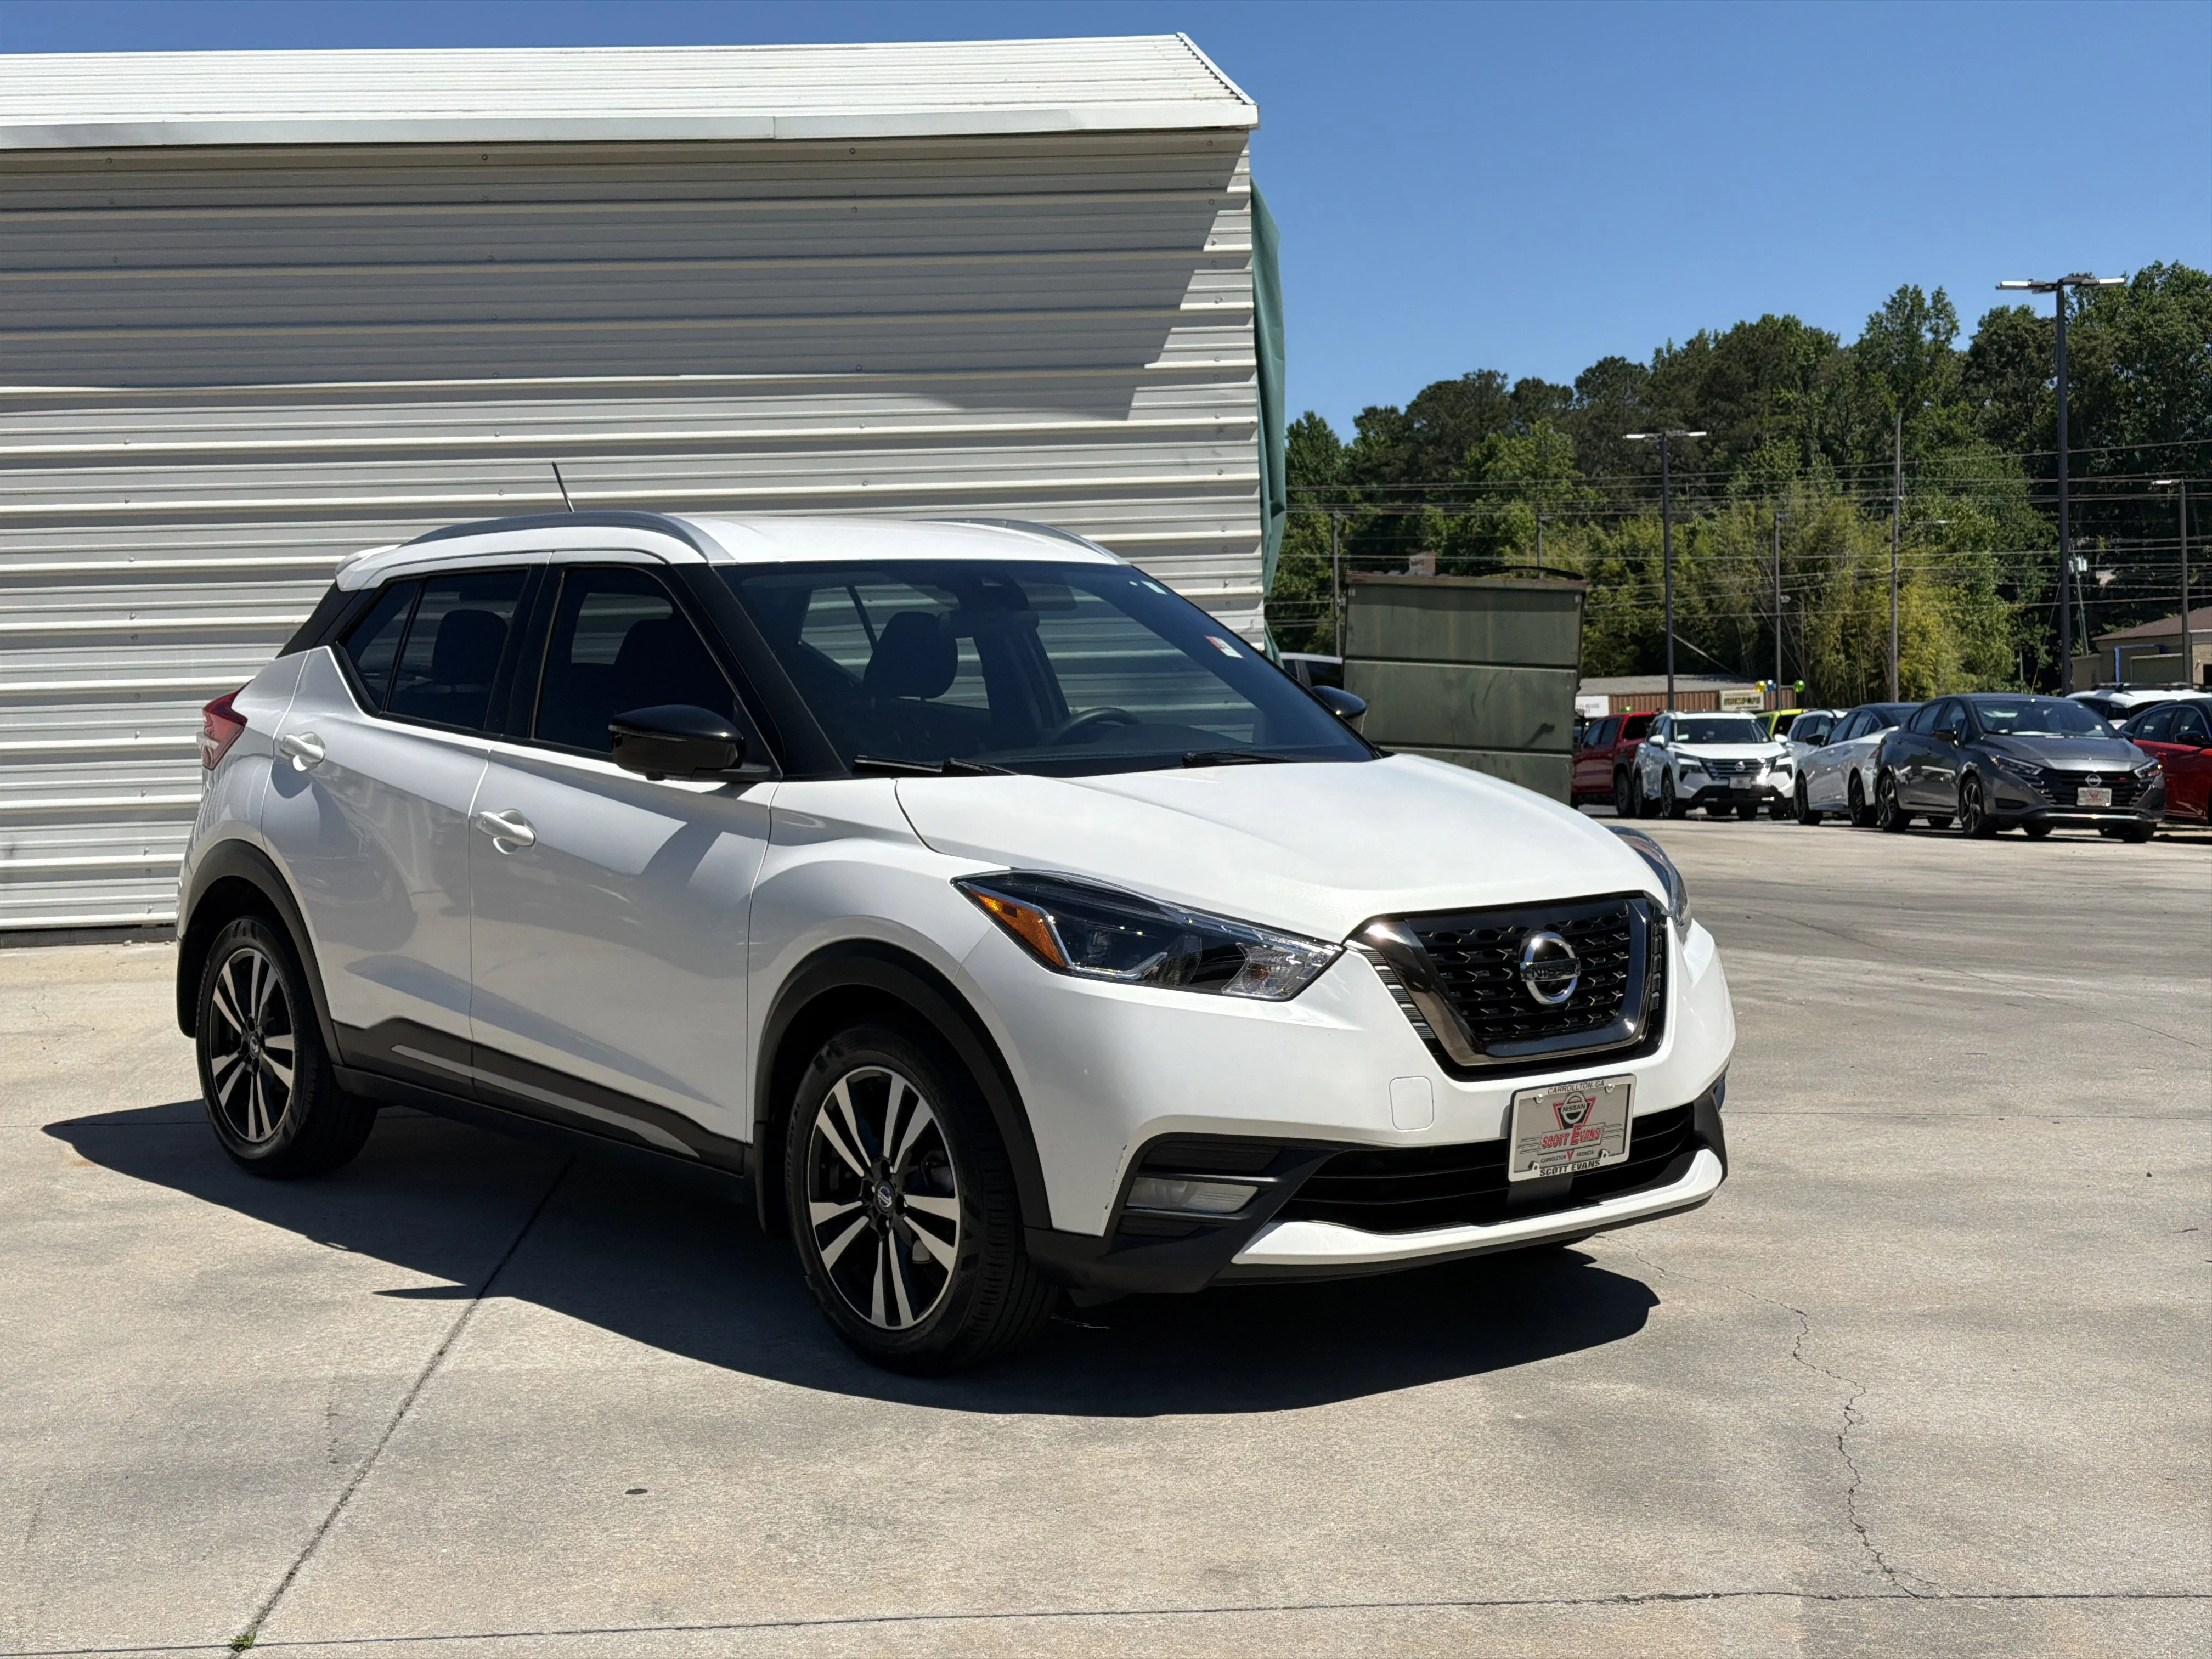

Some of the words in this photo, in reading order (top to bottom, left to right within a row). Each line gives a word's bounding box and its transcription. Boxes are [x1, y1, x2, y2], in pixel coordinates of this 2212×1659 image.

[1542, 1132, 1570, 1149] SCOTT
[1570, 1123, 1601, 1146] EVANS
[1539, 1165, 1569, 1176] SCOTT
[1571, 1159, 1600, 1171] EVANS
[1541, 1155, 1566, 1163] CARROLLTON
